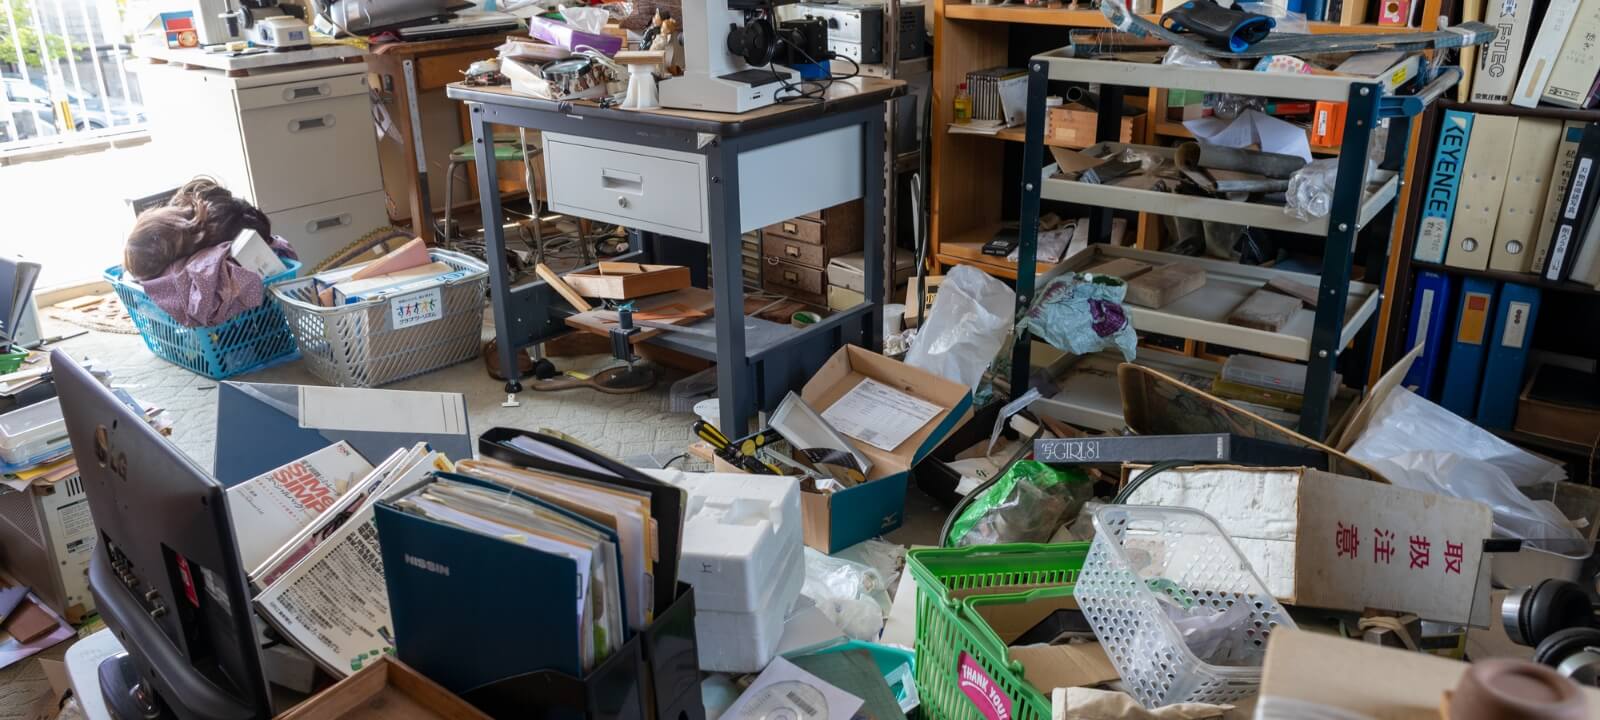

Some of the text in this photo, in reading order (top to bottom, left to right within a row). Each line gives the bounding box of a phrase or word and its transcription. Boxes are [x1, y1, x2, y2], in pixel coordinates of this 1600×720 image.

[1429, 119, 1466, 213] KEYENCE
[404, 553, 450, 576] NISSIN
[1336, 521, 1463, 574] 取扱注意
[962, 664, 988, 692] THANK
